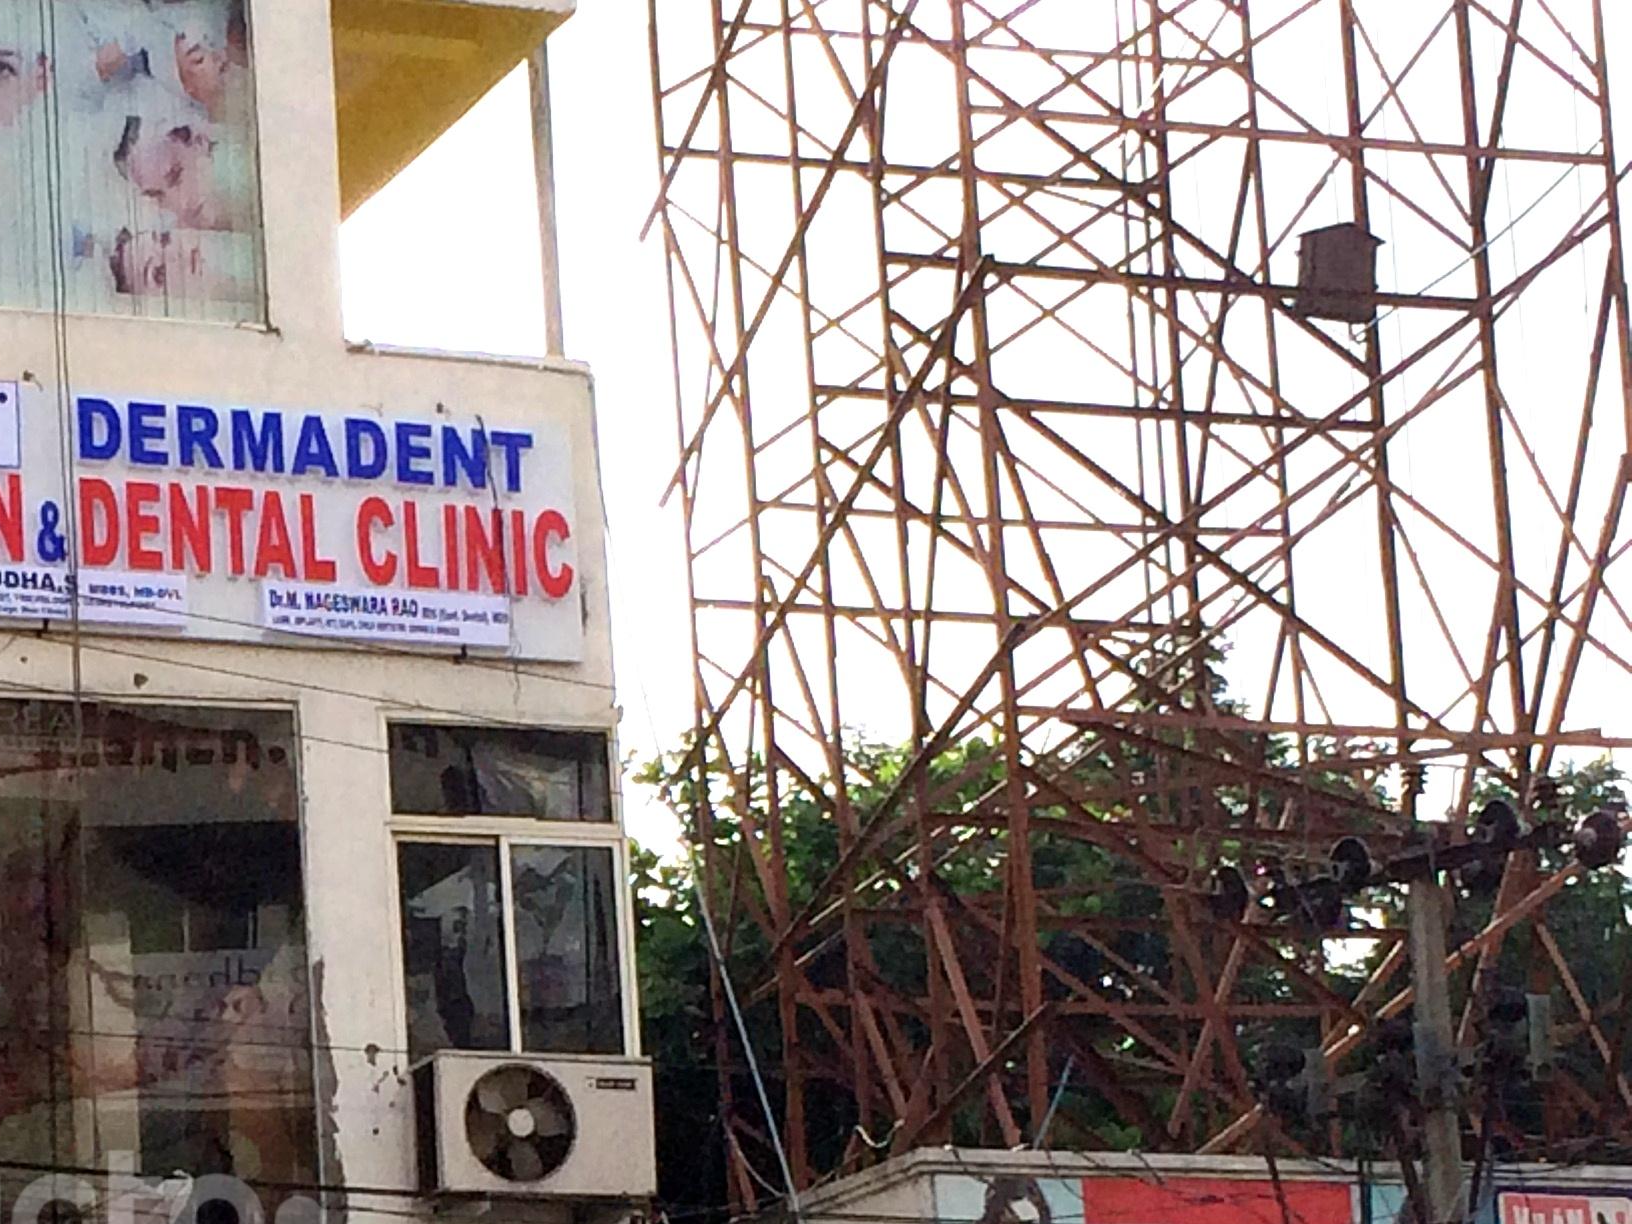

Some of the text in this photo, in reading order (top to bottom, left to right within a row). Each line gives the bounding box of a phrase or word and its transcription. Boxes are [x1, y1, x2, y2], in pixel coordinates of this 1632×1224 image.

[78, 396, 535, 493] DERMADENT
[37, 501, 68, 562] &
[79, 478, 337, 583] DENTAL
[357, 496, 575, 599] CLINIC
